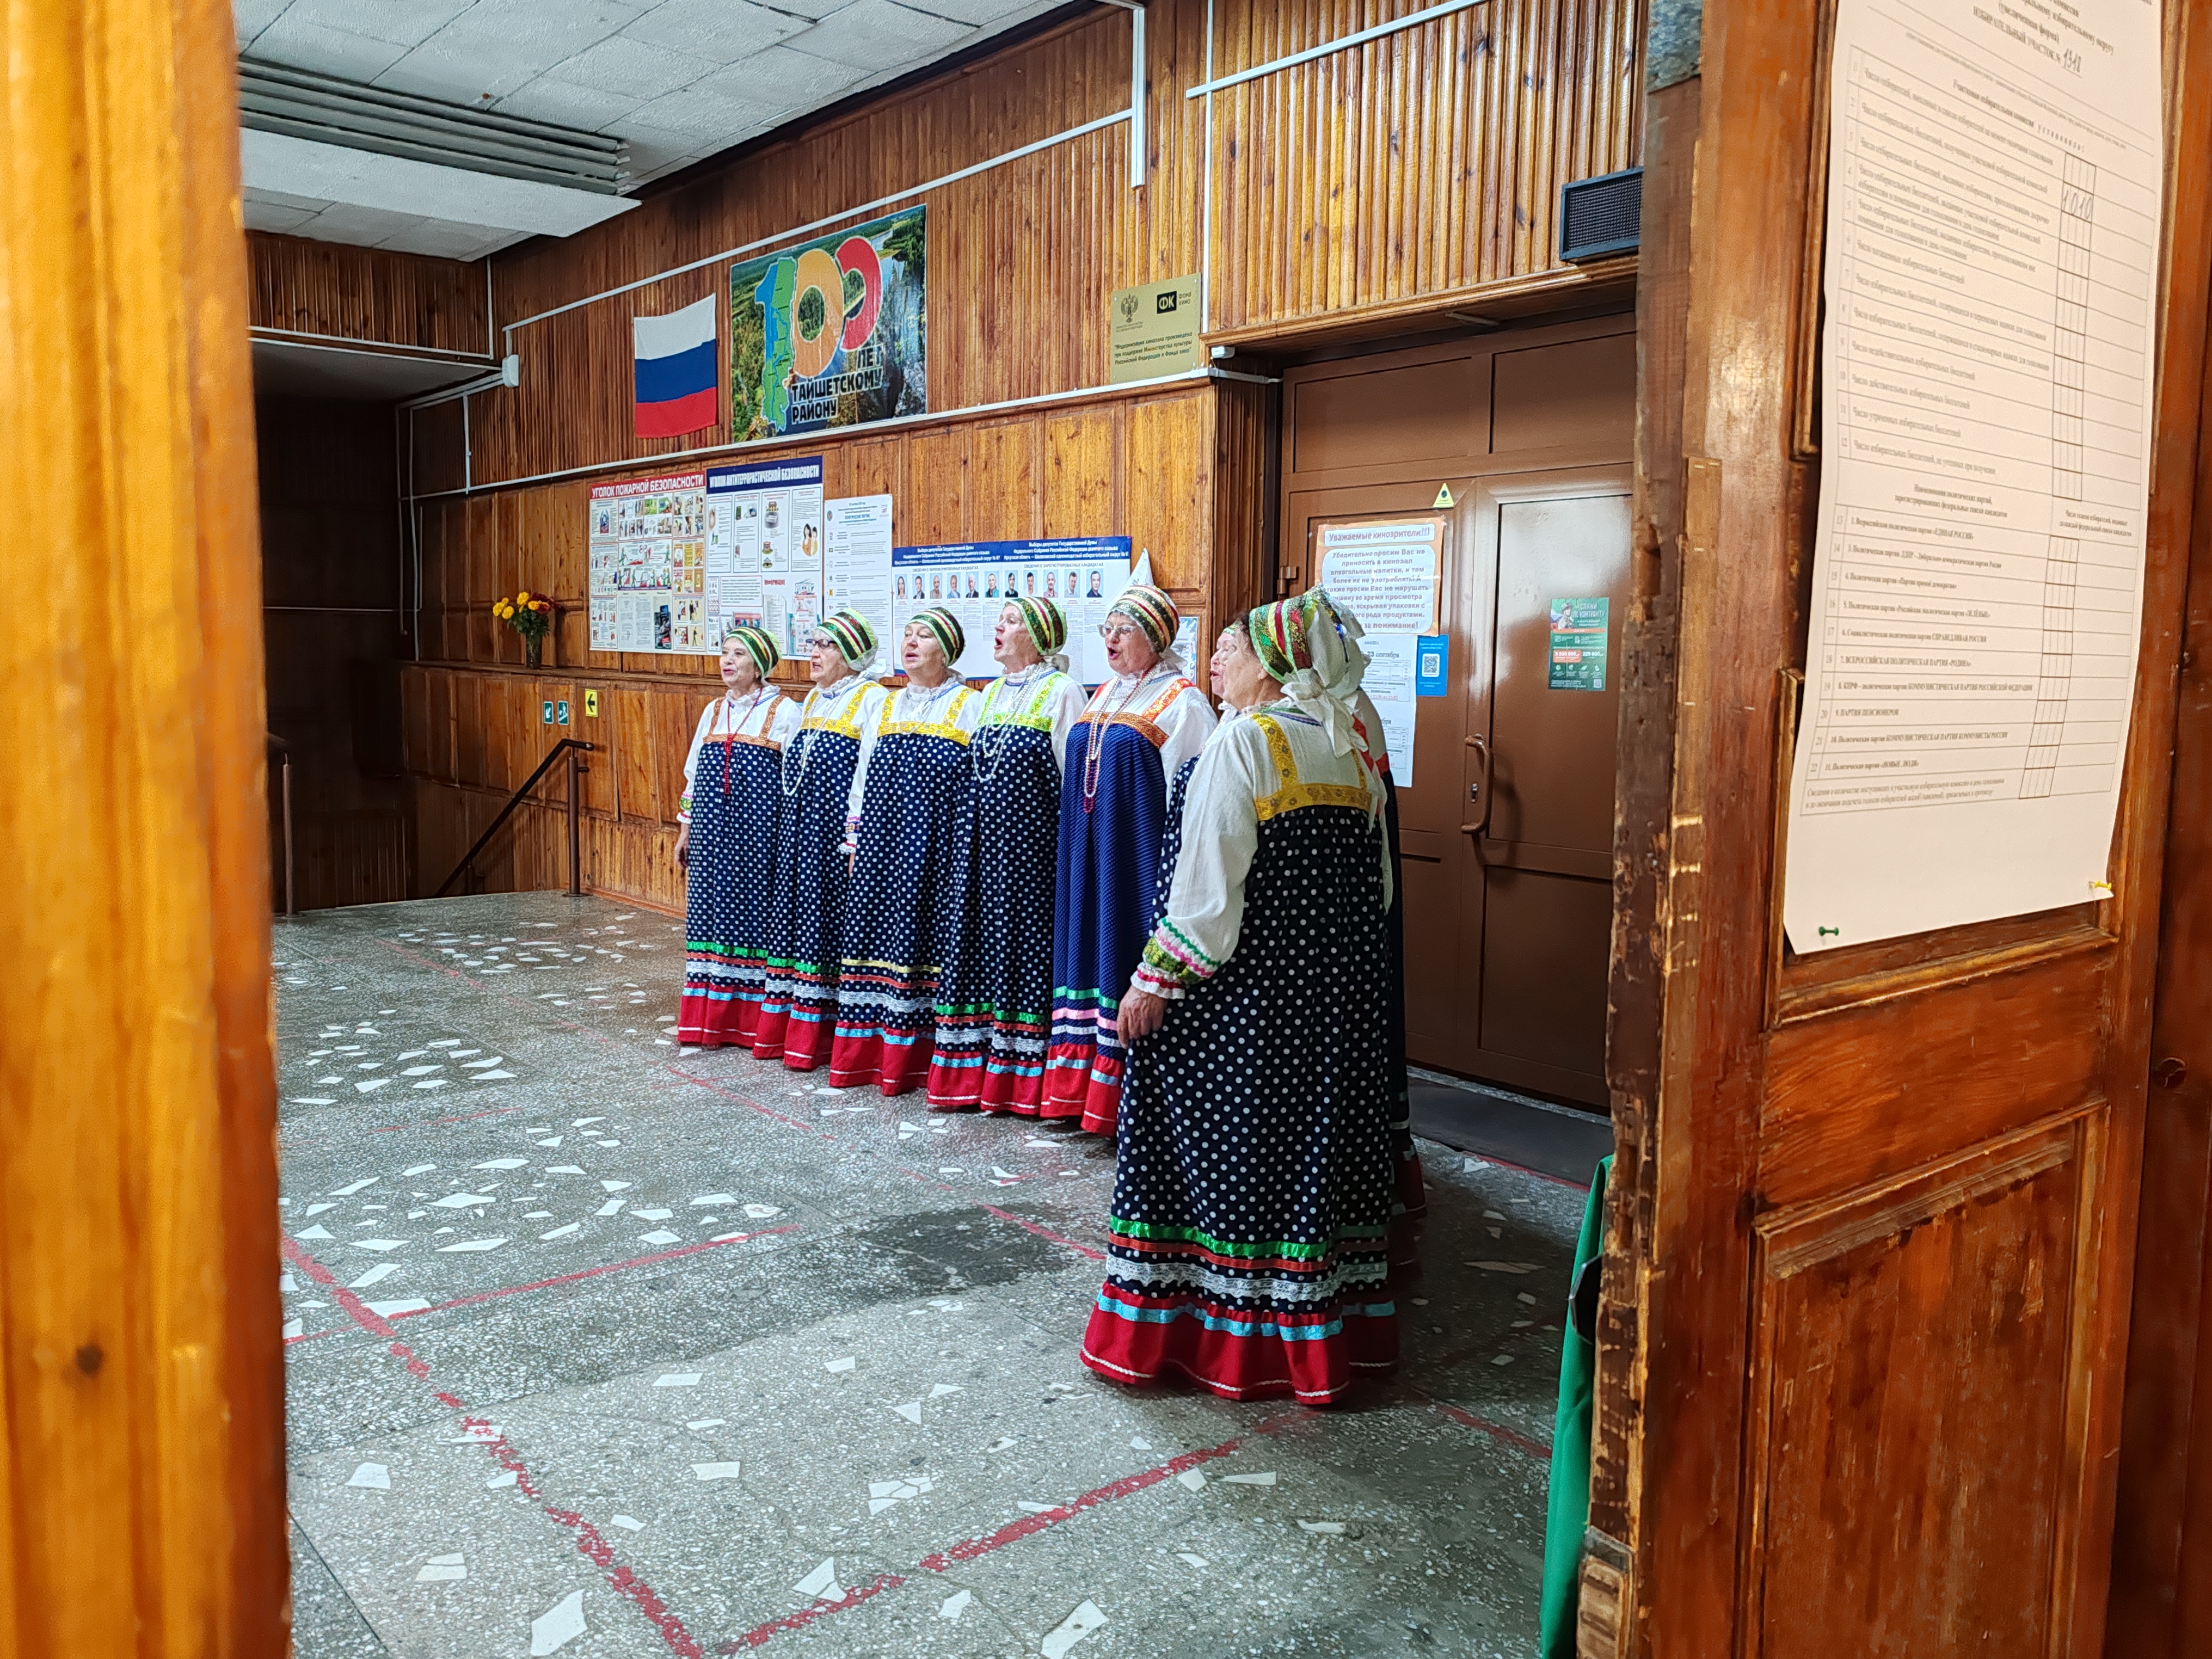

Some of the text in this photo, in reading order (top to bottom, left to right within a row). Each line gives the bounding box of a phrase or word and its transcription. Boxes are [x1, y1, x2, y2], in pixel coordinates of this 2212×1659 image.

[1159, 295, 1174, 310] ФК
[857, 345, 883, 369] ЛЕТ
[792, 370, 882, 402] ТАЙШЕТСКОМУ
[792, 400, 837, 422] РАЙОНУ
[592, 475, 703, 498] УГОЛОК ПОЖАРНОЙ БЕЗОПАСНОСТИ
[709, 464, 819, 488] УГОЛОК АНТИТЕРРОРИСТИЧЕСКОЙ БЕЗОПАСНОСТИ
[1329, 527, 1430, 542] Уважаемые кинозрители!!!
[1374, 549, 1399, 557] просим
[1375, 651, 1399, 659] сентября
